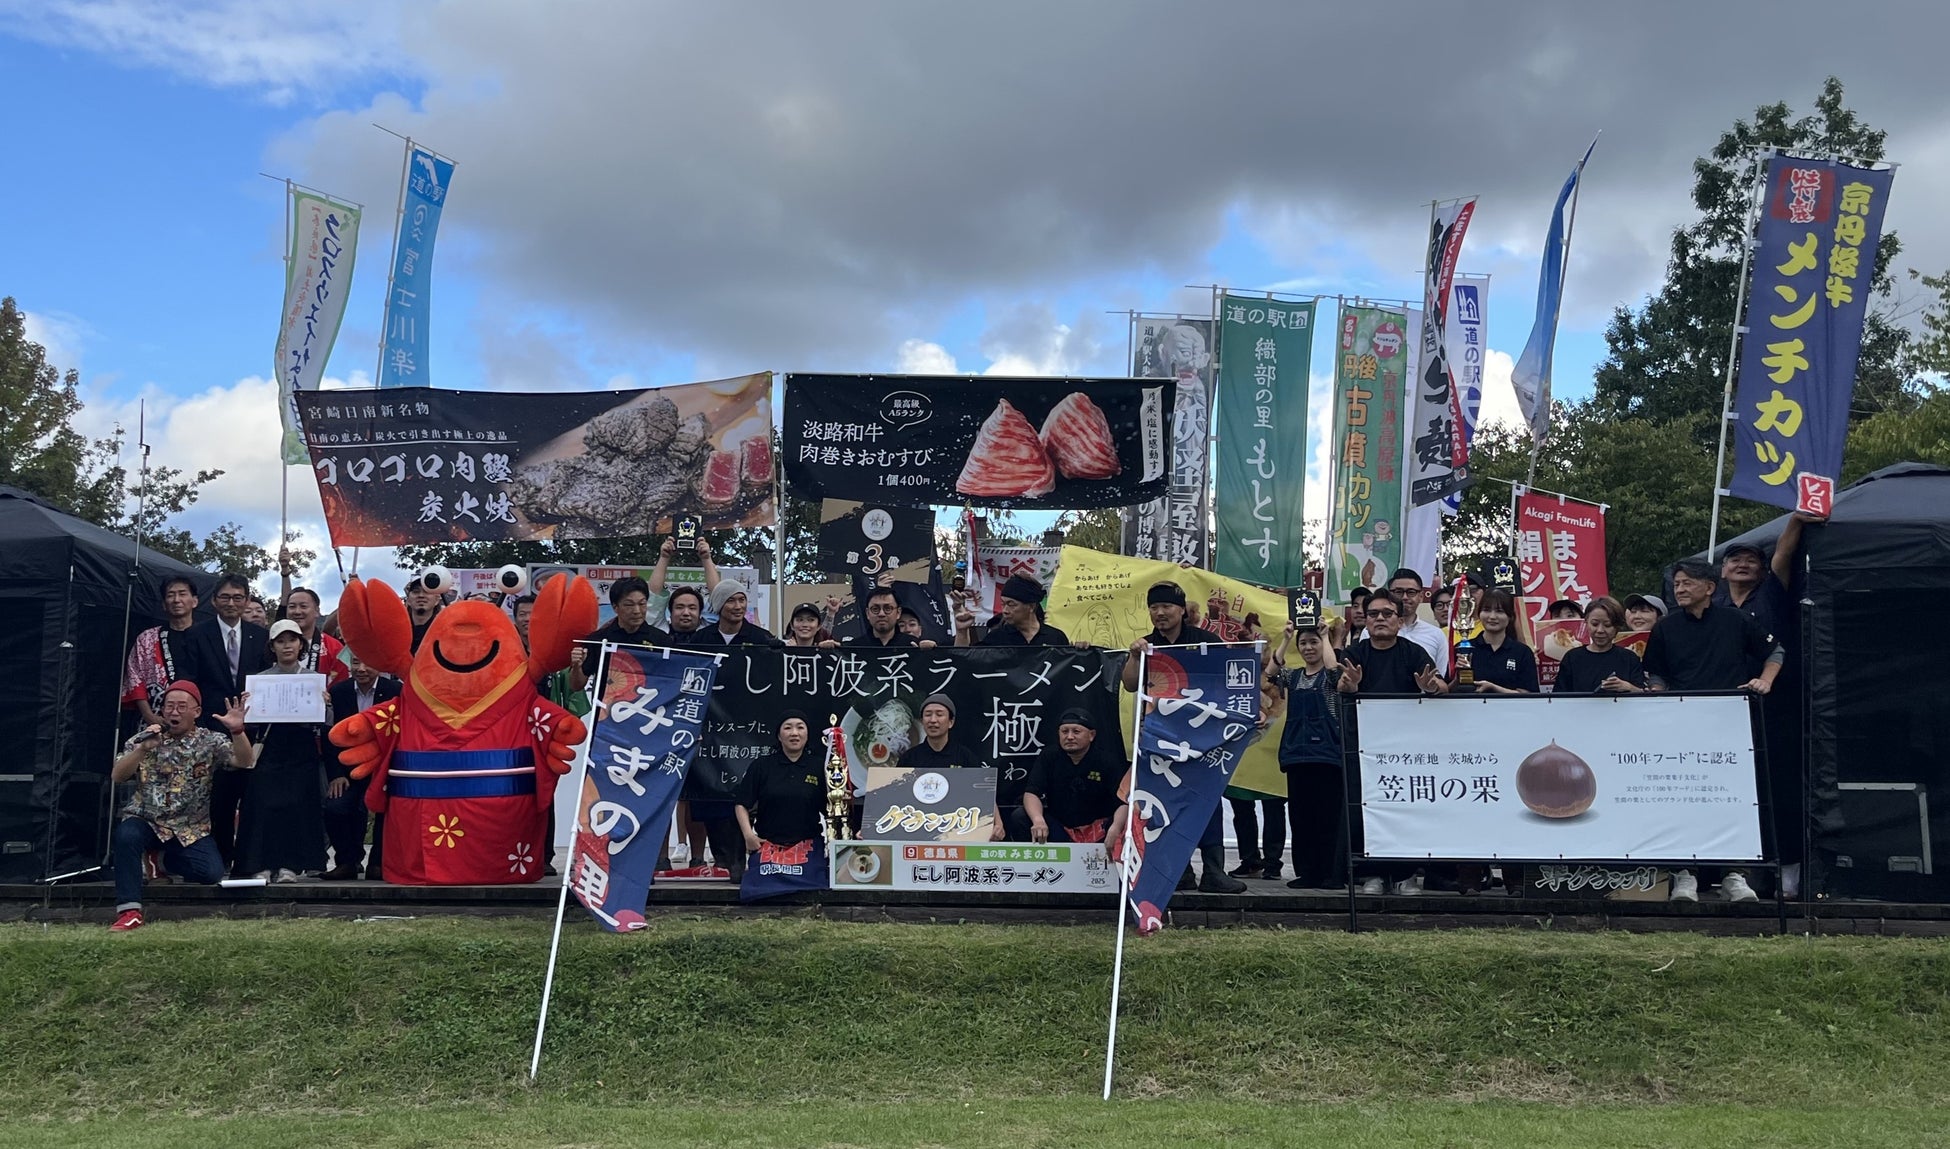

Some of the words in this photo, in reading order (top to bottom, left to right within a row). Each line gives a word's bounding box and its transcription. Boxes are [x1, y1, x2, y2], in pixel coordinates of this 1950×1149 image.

[391, 247, 419, 386] 富士川楽
[1226, 304, 1287, 328] 道の駅
[1461, 327, 1481, 385] 道の駅
[1753, 232, 1819, 487] メンチカツ
[1253, 337, 1277, 430] 織部の里
[308, 401, 430, 420] 宮崎日南新名物
[888, 409, 925, 418] A5ランク
[893, 399, 920, 409] 最高級
[802, 419, 885, 442] 淡路和牛
[799, 444, 934, 468] 肉巻きおむすび
[877, 473, 931, 487] 1個400円
[417, 490, 518, 525] 炭火焼
[1241, 438, 1279, 569] もとす
[1524, 507, 1554, 523] Akagi
[1556, 512, 1597, 529] FarmLife
[659, 698, 704, 780] 道の駅
[981, 696, 1046, 759] 極
[1200, 693, 1257, 776] 道の駅
[1376, 753, 1440, 766] 栗の名産地
[1448, 753, 1499, 766] 茨城から
[1377, 774, 1501, 803] 笠間の栗
[876, 804, 981, 835] グランプリ
[906, 848, 915, 858] 9
[923, 847, 959, 859] 徳島県
[980, 849, 1007, 858] 道の駅
[1010, 848, 1059, 860] みまの里
[912, 865, 1065, 885] にし阿波系ラーメン
